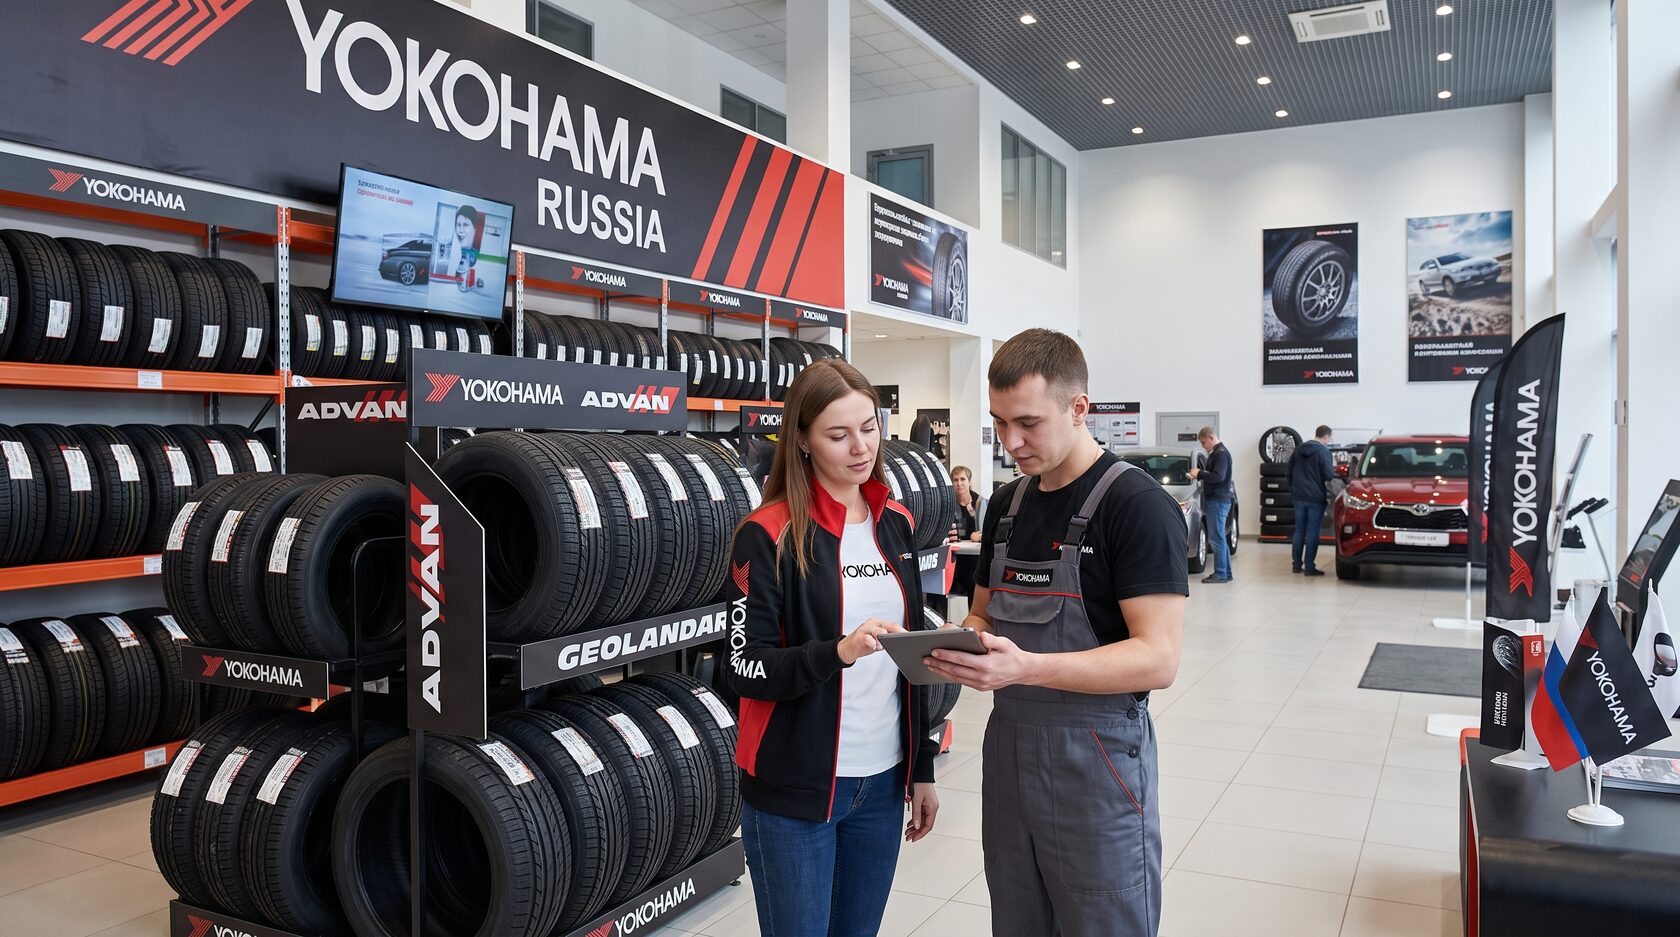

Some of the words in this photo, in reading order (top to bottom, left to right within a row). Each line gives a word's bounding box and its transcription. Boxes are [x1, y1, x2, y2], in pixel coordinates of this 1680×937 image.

[286, 0, 666, 196] YOKOHAMA
[83, 176, 186, 212] YOKOHAMA
[537, 178, 667, 254] RUSSIA
[584, 269, 627, 288] YOKOHAMA
[882, 276, 909, 294] YOKOHAMA
[708, 291, 741, 308] YOKOHAMA
[802, 309, 829, 323] YOKOHAMA
[1314, 370, 1355, 378] YOKOHAMA
[460, 378, 564, 406] YOKOHAMA
[580, 390, 670, 412] ADVAN
[297, 400, 407, 420] ADVAN
[759, 413, 783, 426] YOKOH
[1512, 378, 1541, 547] YOKOHAMA
[841, 563, 892, 579] YOKOHA
[1015, 572, 1050, 583] YOKOHAMA
[421, 504, 441, 714] ADVAN
[557, 610, 728, 671] GEOLANDAR
[224, 659, 303, 688] YOKOHAMA
[1586, 650, 1638, 745] YOKOHAMA
[615, 877, 696, 937] YOKOHAMA
